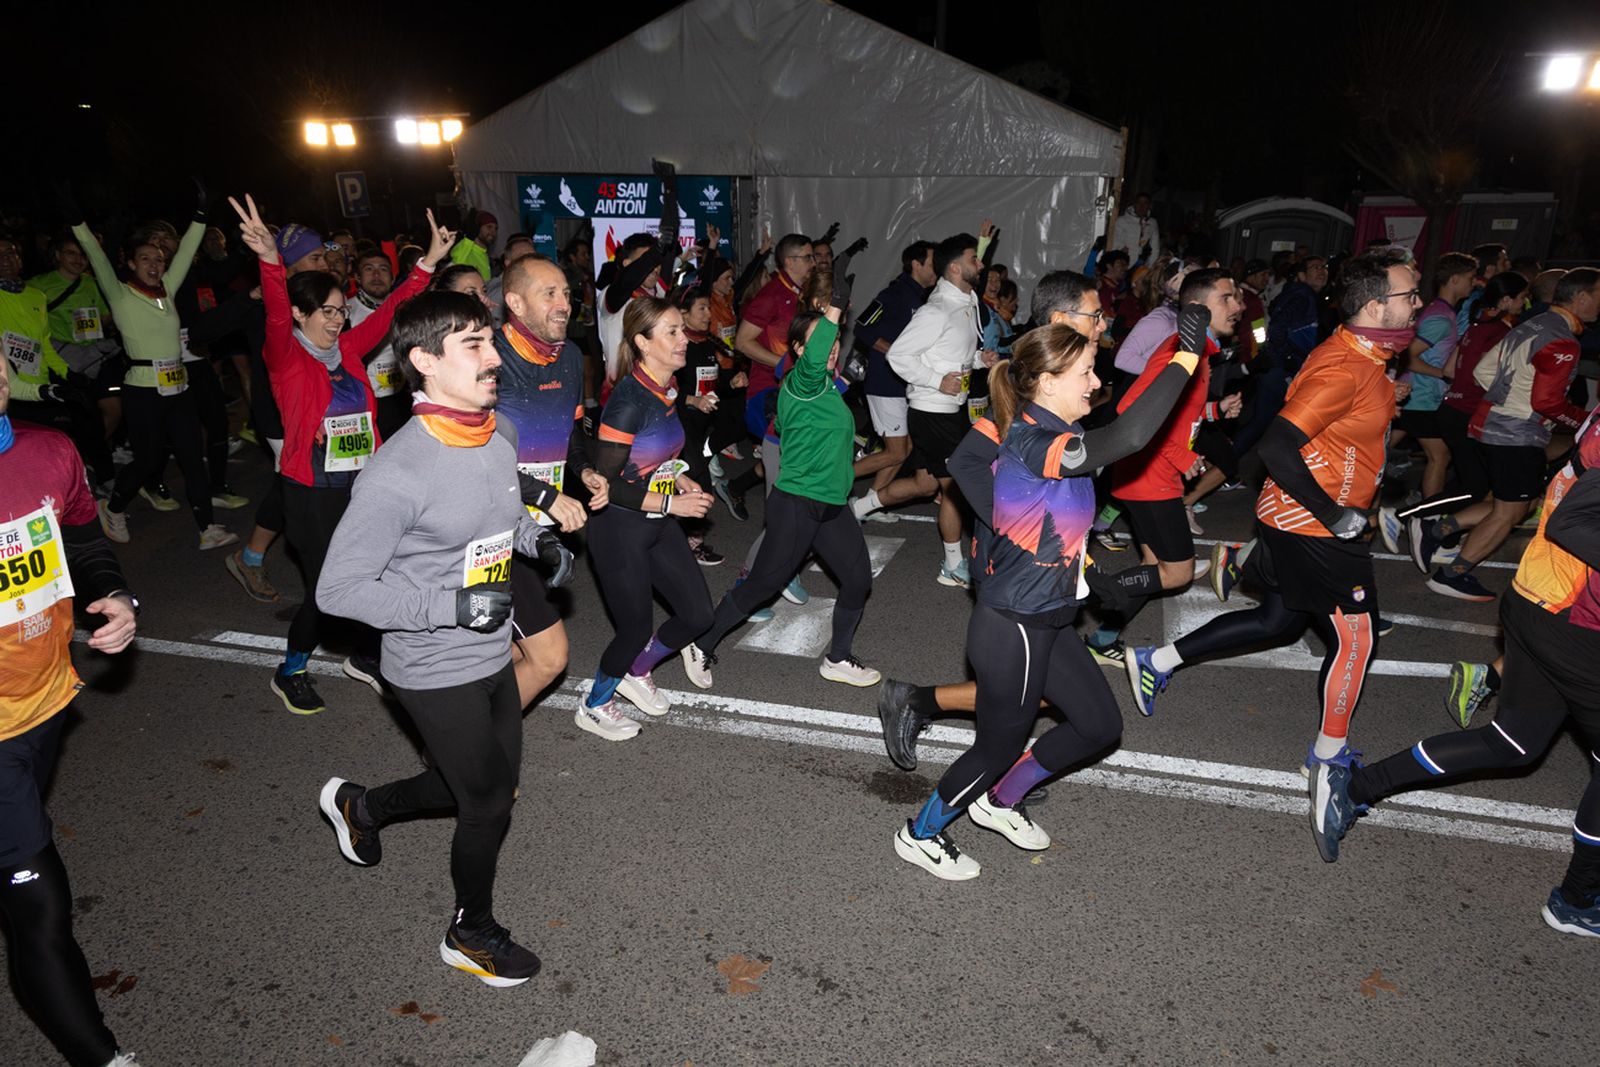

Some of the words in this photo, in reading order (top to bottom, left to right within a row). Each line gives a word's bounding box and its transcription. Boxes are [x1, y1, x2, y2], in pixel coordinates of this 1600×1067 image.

[343, 177, 362, 203] P
[597, 182, 616, 199] 43
[617, 183, 648, 197] SAN
[594, 196, 646, 214] ANTÓN
[9, 346, 36, 363] 1388
[338, 433, 369, 453] 4905
[7, 532, 20, 544] DE
[0, 549, 46, 593] 650
[473, 557, 491, 568] SAN
[1333, 614, 1360, 715] QUIEBRAJANO
